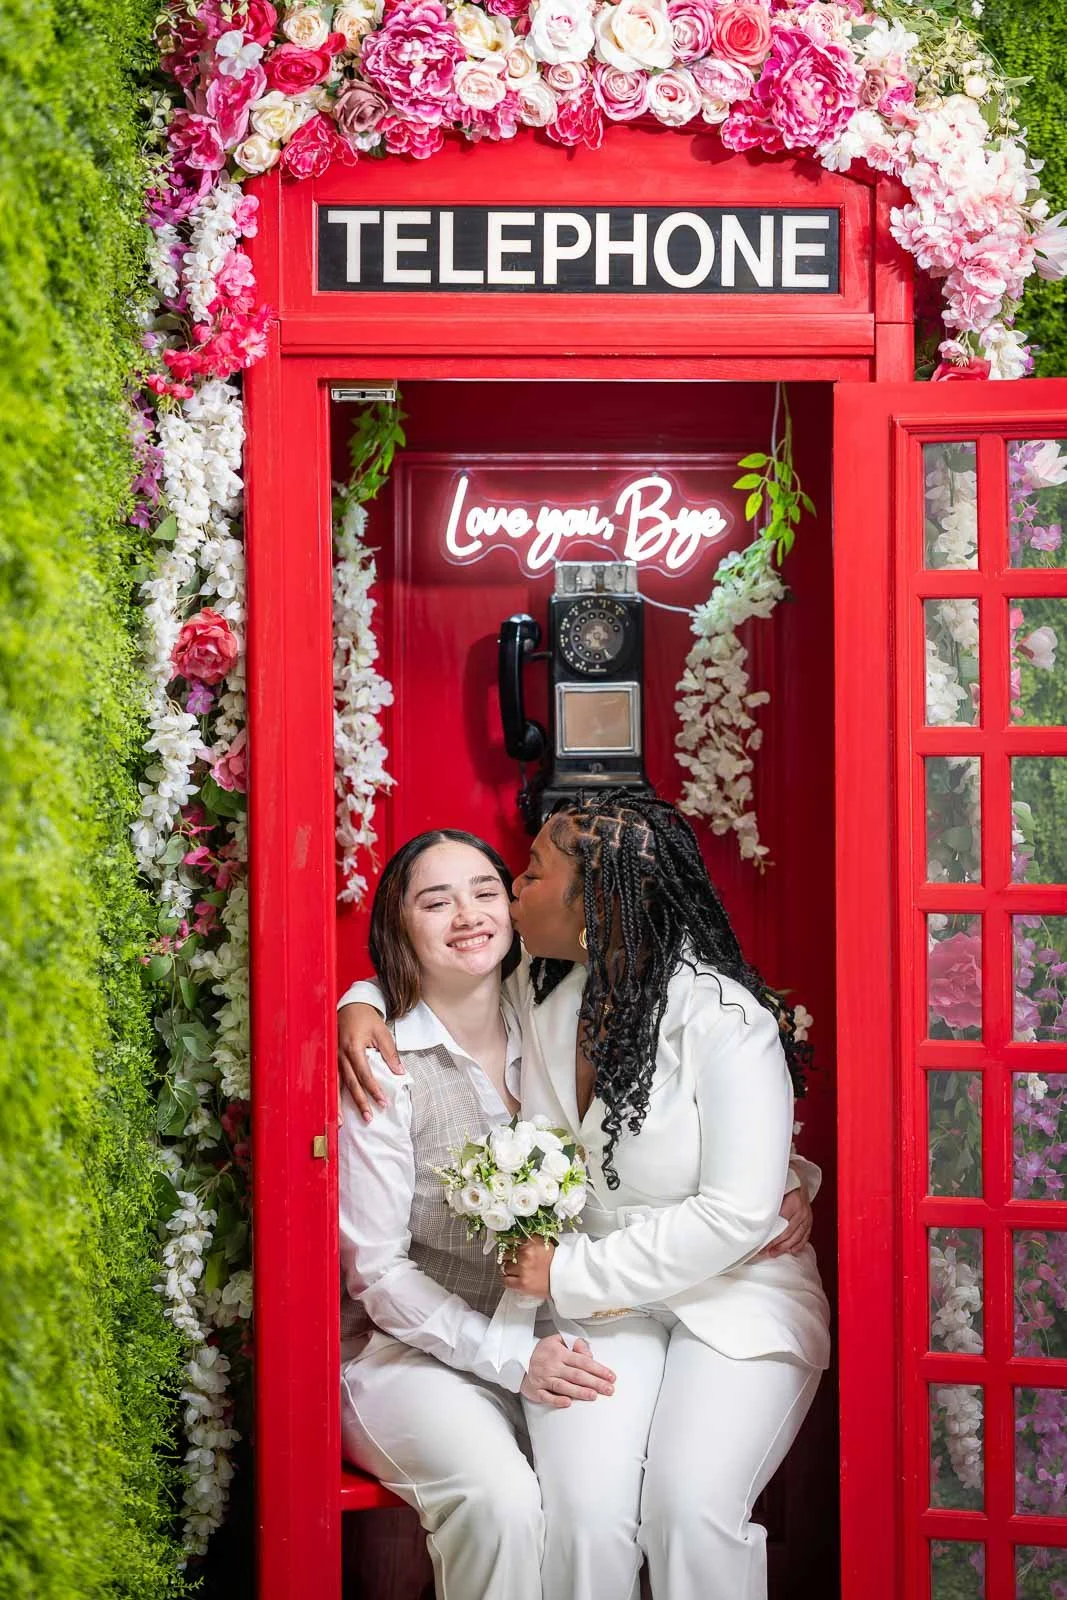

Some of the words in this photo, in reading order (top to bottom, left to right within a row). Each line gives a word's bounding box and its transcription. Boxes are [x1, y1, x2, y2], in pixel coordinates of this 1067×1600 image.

[328, 210, 830, 288] TELEPHONE
[446, 476, 533, 556] Love
[527, 506, 615, 570] you,
[615, 476, 727, 569] Bye
